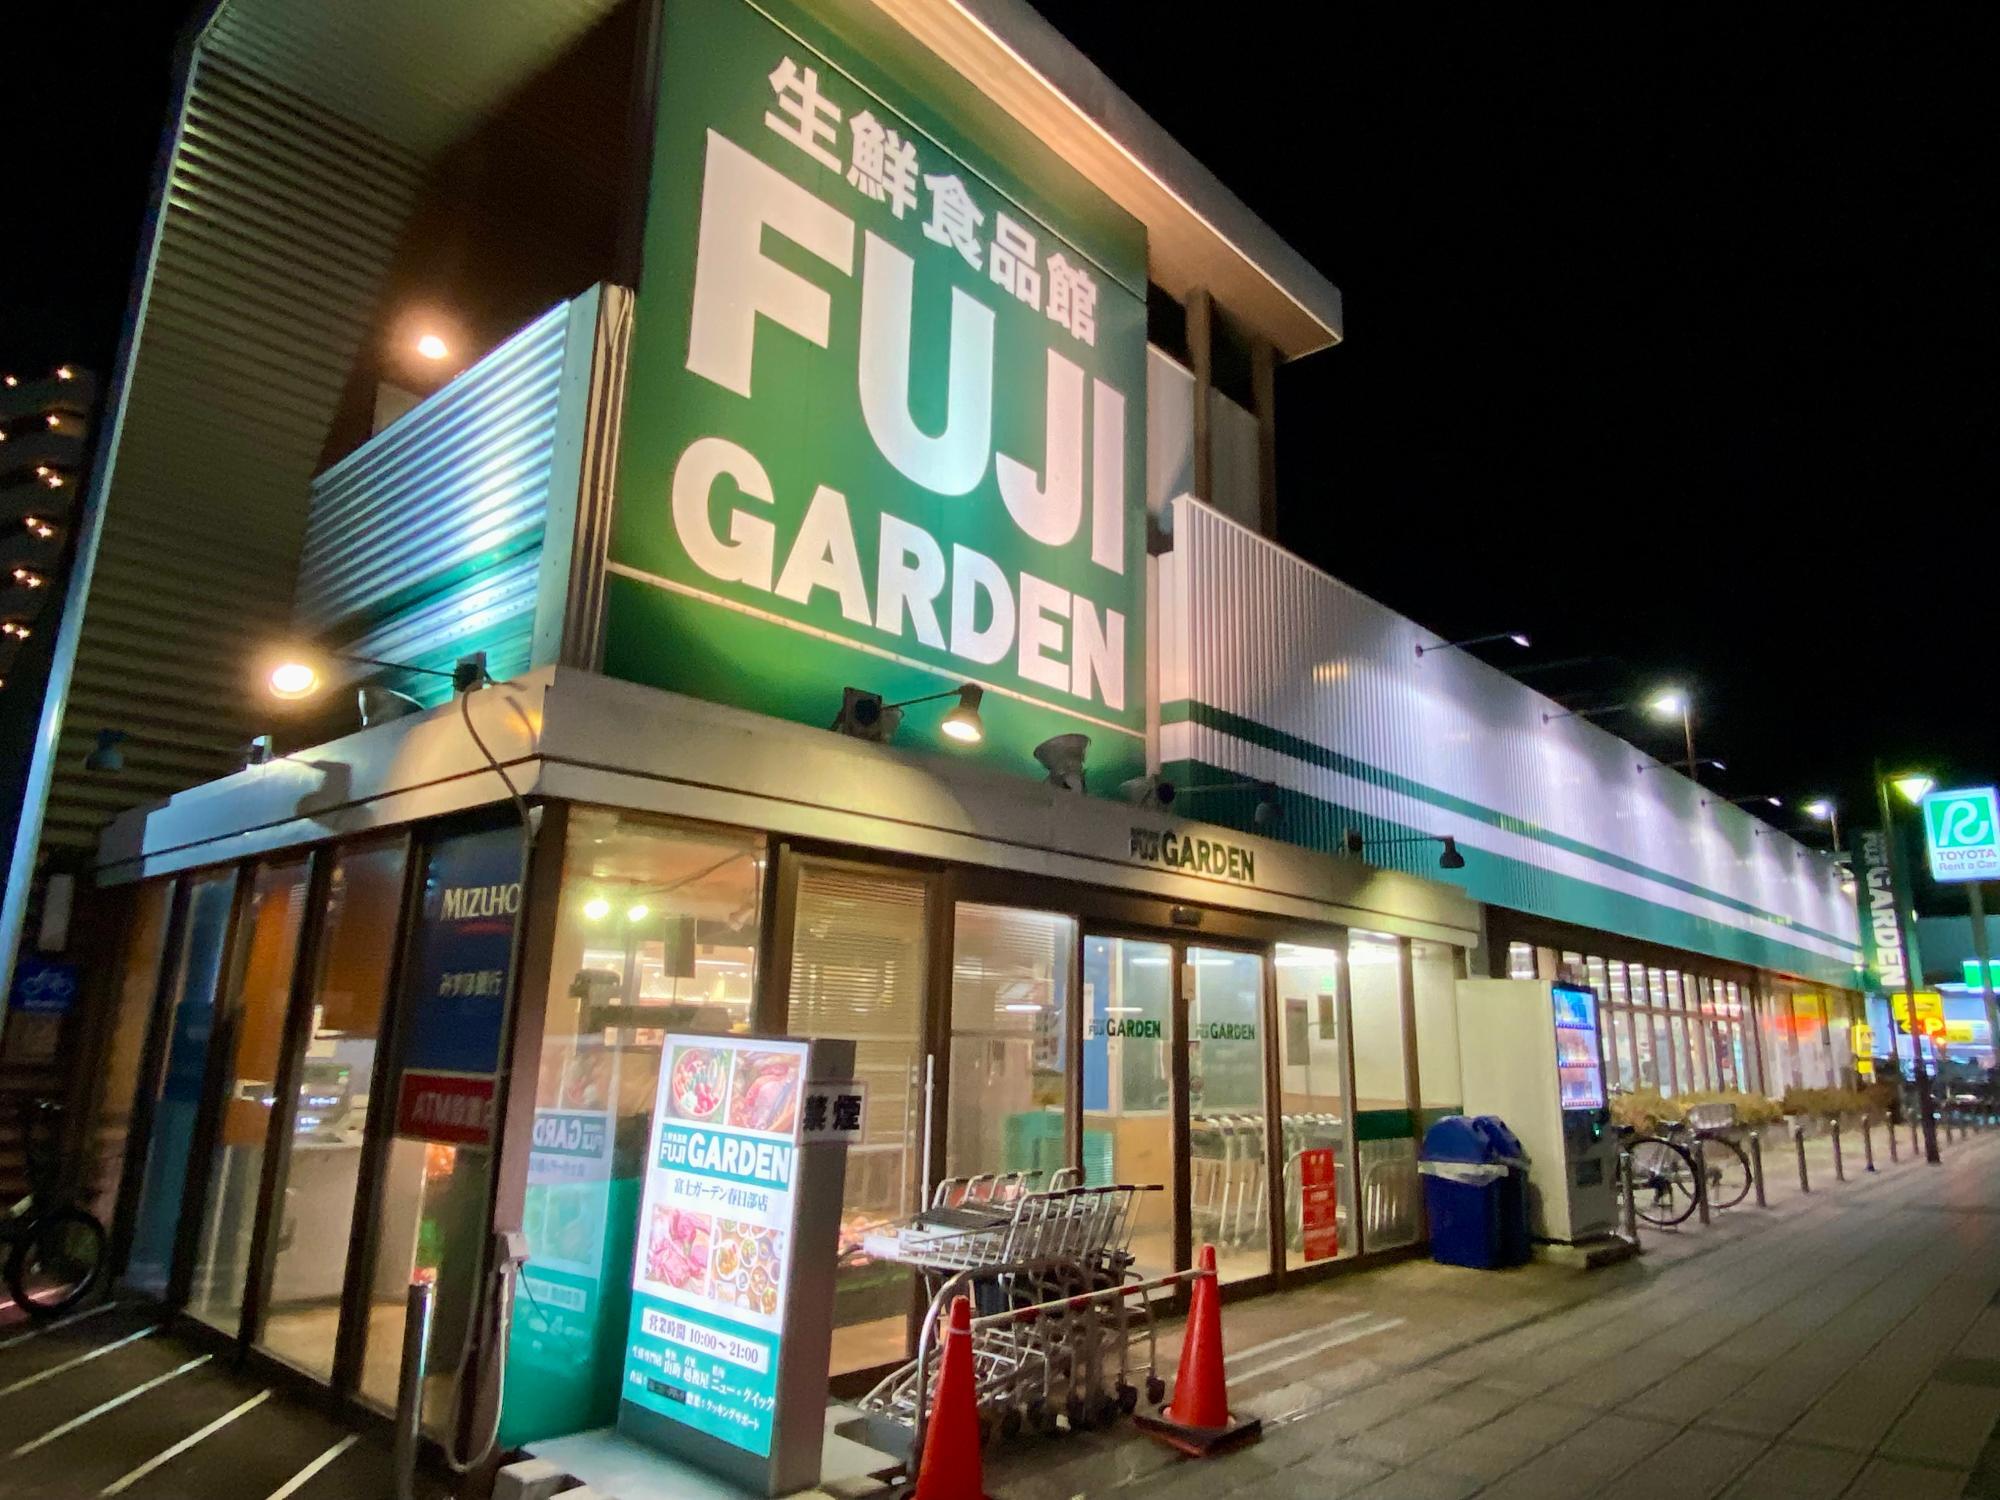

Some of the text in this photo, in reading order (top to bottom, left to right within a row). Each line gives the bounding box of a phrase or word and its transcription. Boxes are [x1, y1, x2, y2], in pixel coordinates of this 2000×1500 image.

[764, 55, 1096, 347] 生鮮食品館
[686, 128, 1126, 575] FUJI
[671, 436, 1126, 712] GARDEN
[1162, 829, 1255, 882] GARDEN
[1937, 849, 1998, 861] TOYOTA
[1939, 862, 1965, 871] Rent
[1976, 860, 1997, 869] Car
[440, 883, 521, 920] MIZUHO
[1866, 866, 1906, 986] GARDEN
[1107, 1018, 1161, 1038] GARDEN
[1210, 1022, 1255, 1040] GARDEN
[803, 1094, 862, 1131] 禁煙
[660, 1132, 791, 1184] FUJI GARDEN
[674, 1178, 768, 1212] 富士ガーデン春日部店
[649, 1313, 686, 1341] 営業時間
